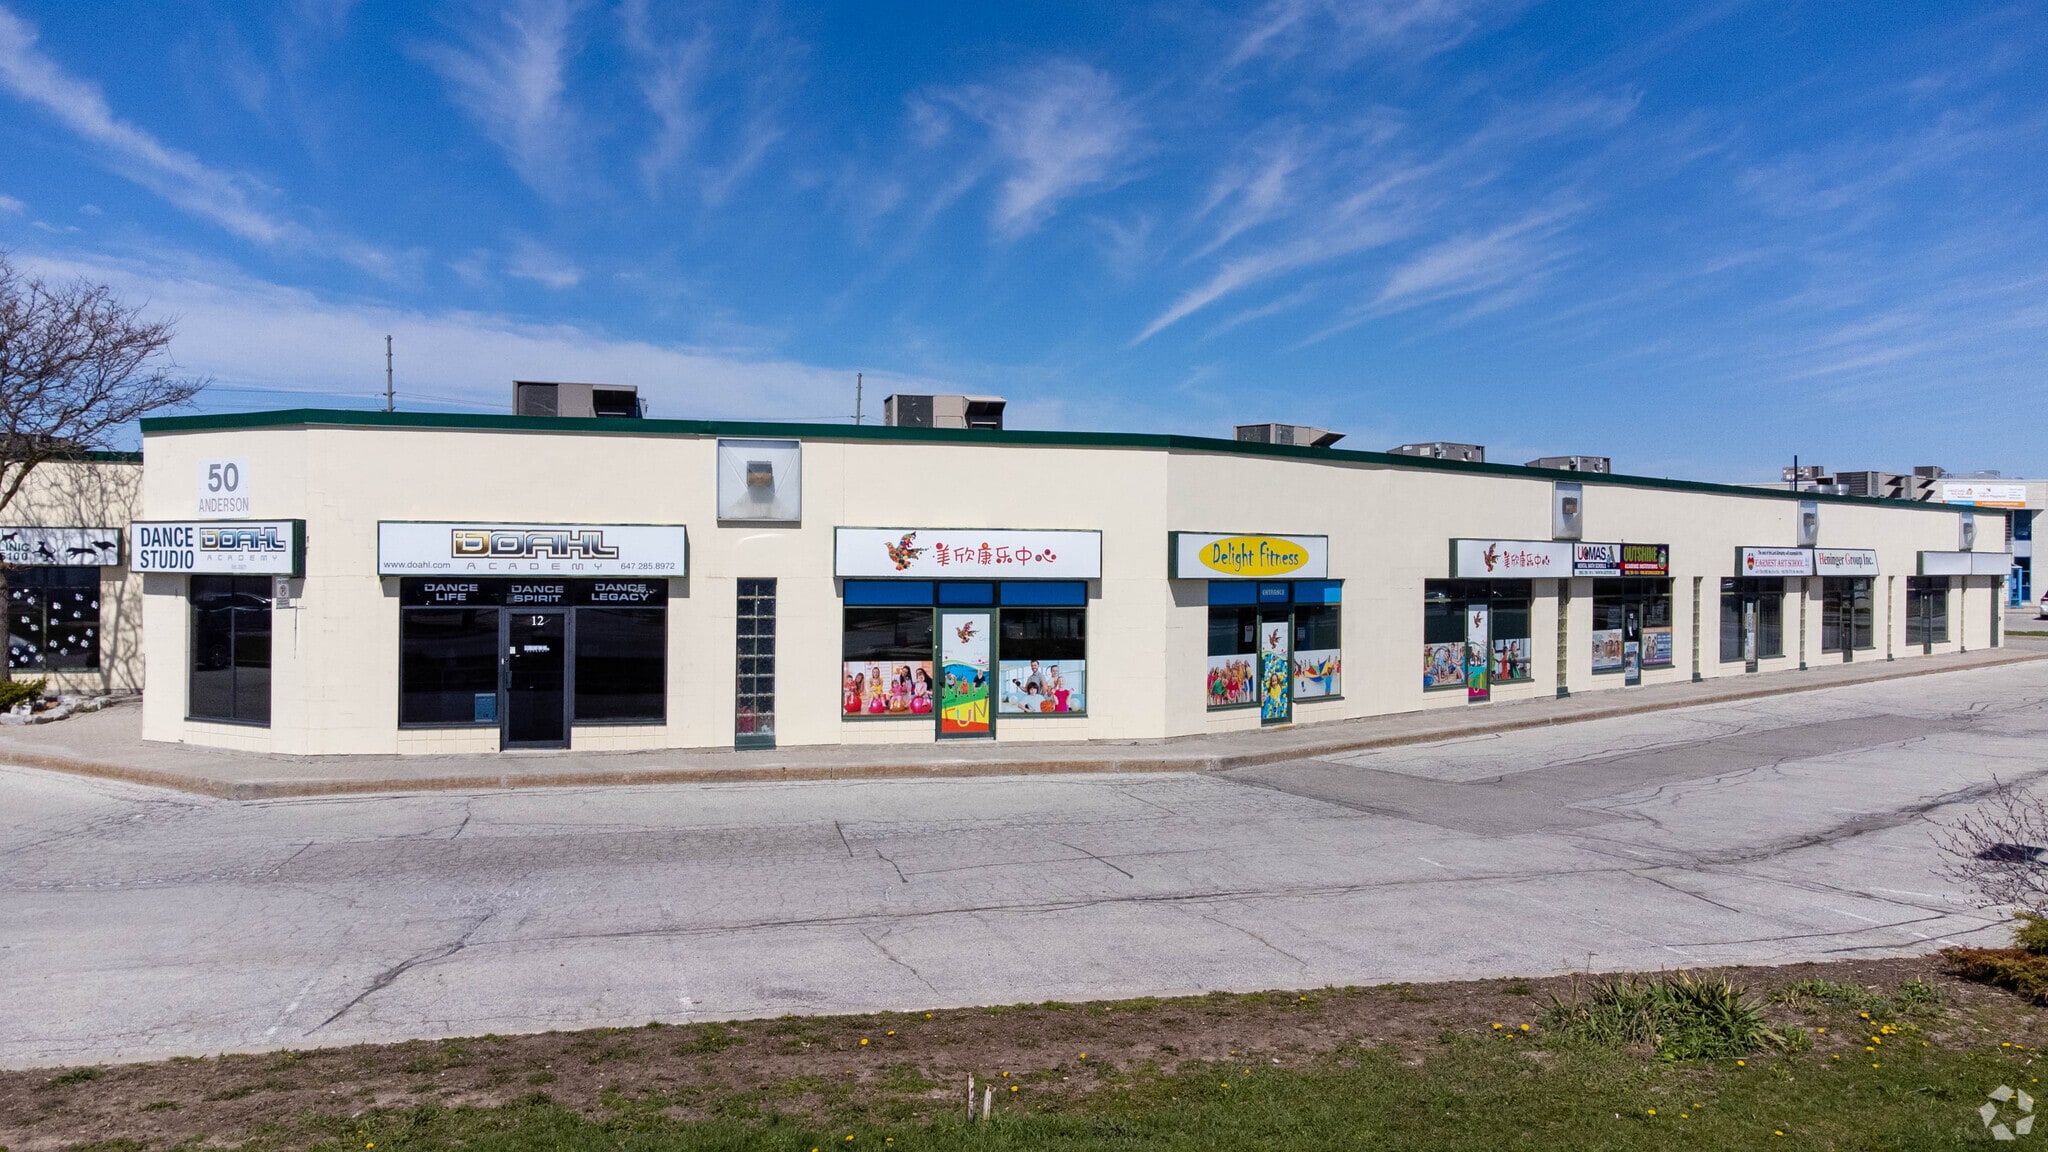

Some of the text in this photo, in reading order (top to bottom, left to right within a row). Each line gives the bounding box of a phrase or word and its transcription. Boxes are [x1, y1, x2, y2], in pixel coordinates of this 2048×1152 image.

[208, 462, 239, 492] 50
[199, 497, 249, 512] ANDERSON
[141, 527, 193, 548] DANCE
[452, 529, 619, 559] DOAHL
[140, 550, 194, 568] STUDIO
[936, 542, 1057, 566] 美欣康乐中心
[1213, 541, 1299, 572] Delight Fitness
[384, 561, 450, 569] www.doahl.com
[466, 562, 603, 570] ACADEMY
[620, 562, 675, 570] 647.285.8972
[1845, 553, 1862, 568] Group
[1863, 553, 1874, 565] Inc.
[424, 583, 478, 592] DANCE
[511, 585, 564, 593] DANCE
[595, 583, 647, 592] DANCE
[436, 593, 466, 601] LIFE
[514, 594, 561, 602] SPIRIT
[591, 593, 649, 601] LEGACY
[532, 615, 544, 626] 12
[943, 698, 988, 727] FUN
